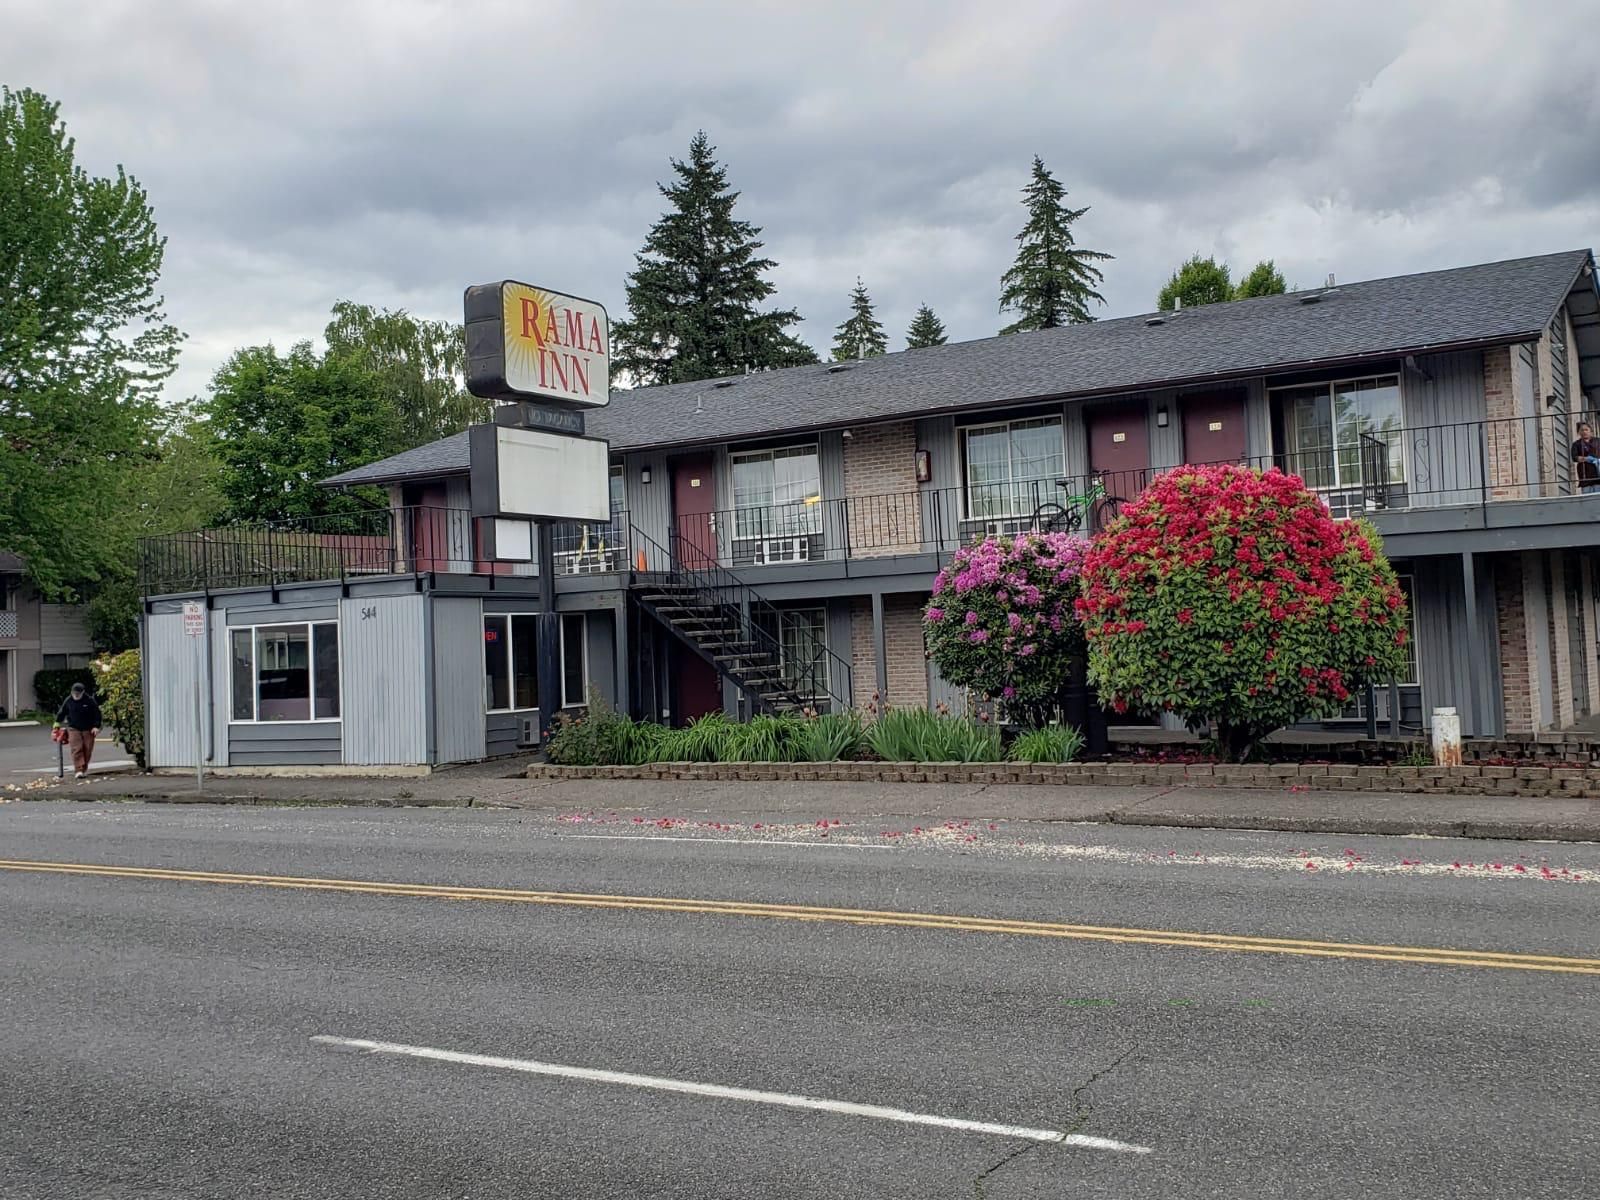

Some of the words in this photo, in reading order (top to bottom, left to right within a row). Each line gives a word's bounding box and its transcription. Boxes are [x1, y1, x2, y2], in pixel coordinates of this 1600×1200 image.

[519, 297, 605, 355] RAMA
[538, 347, 590, 396] INN
[361, 605, 377, 621] 544
[485, 631, 497, 641] EN
